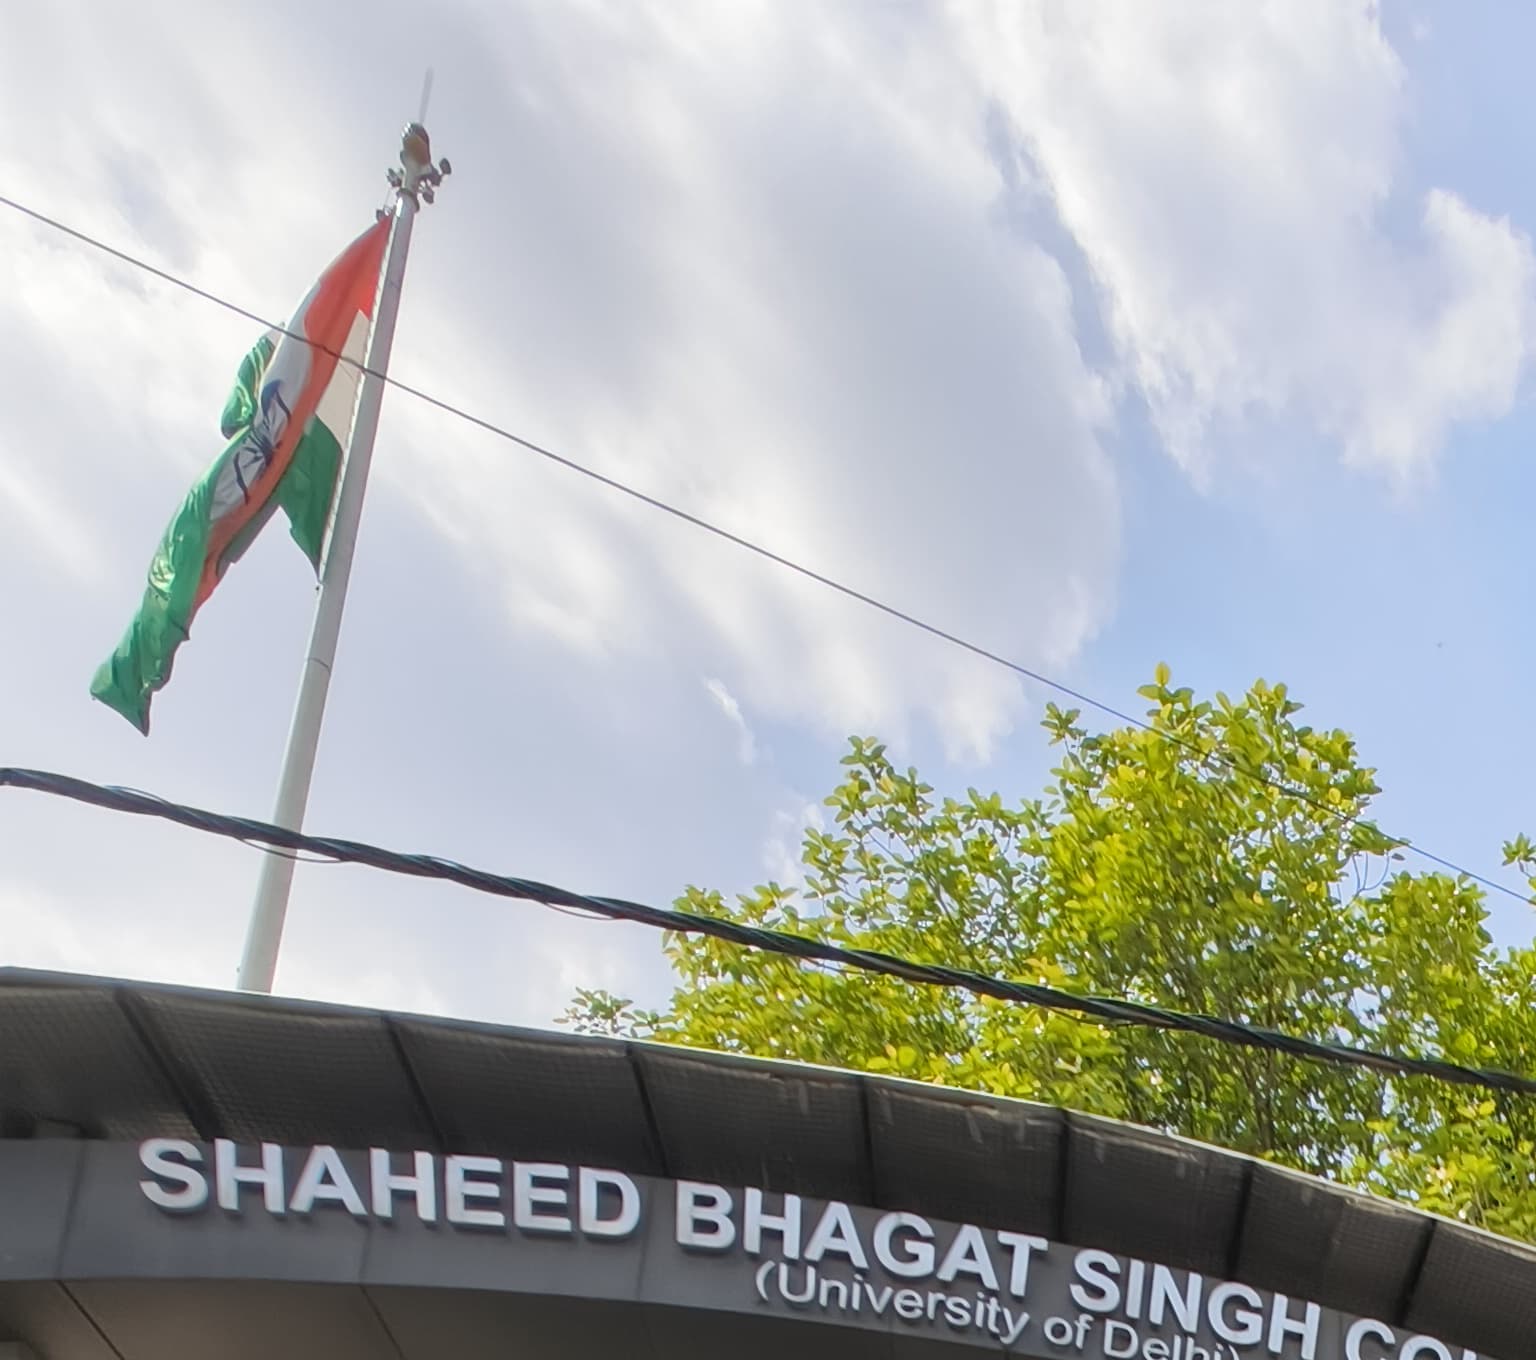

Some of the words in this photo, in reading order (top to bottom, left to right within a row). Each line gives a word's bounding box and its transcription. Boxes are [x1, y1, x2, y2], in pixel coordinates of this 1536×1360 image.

[138, 1137, 642, 1238] SHAHEED
[675, 1179, 1049, 1297] BHAGAT
[755, 1260, 1030, 1345] (University
[1043, 1313, 1095, 1350] of
